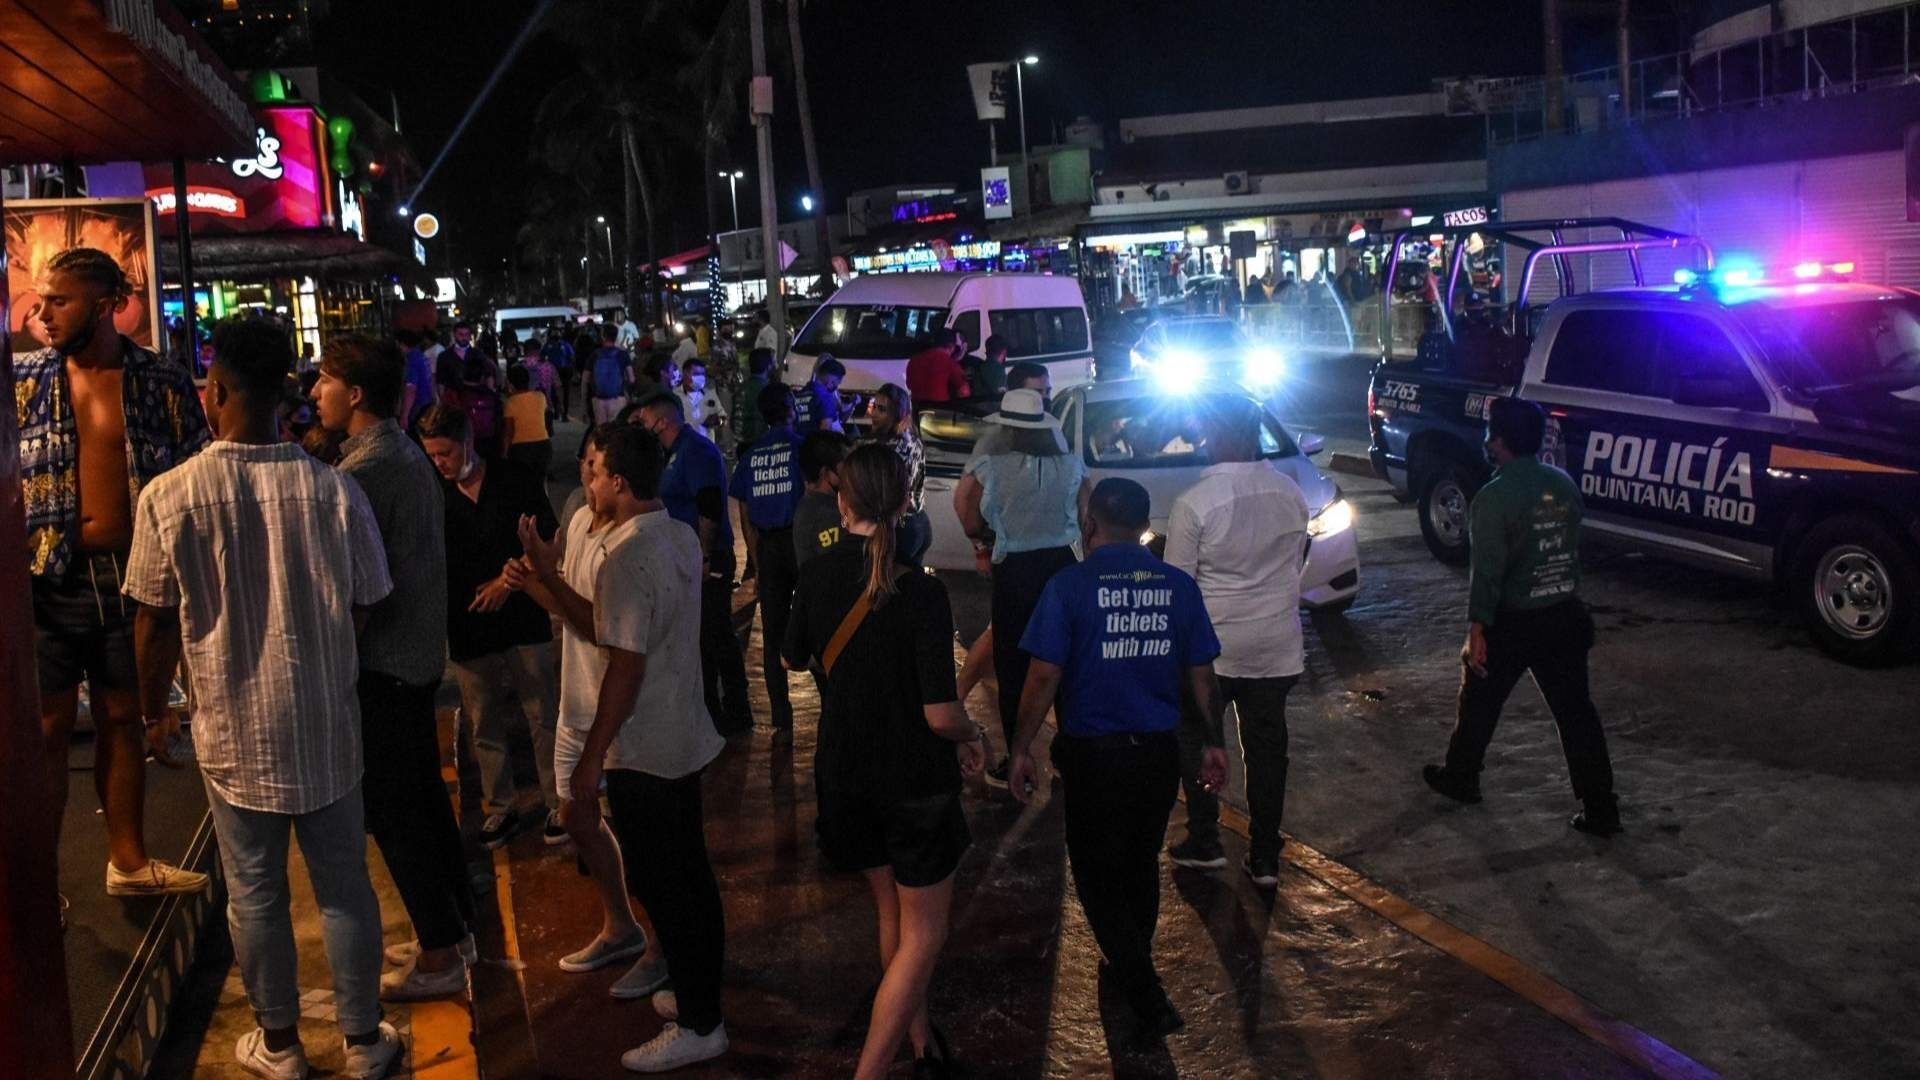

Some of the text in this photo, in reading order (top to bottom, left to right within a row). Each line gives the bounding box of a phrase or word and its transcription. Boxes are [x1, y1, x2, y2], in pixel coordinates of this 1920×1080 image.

[1444, 208, 1486, 227] TACOS
[1382, 380, 1420, 401] 5765
[750, 451, 792, 468] Get your
[1583, 430, 1753, 499] POLICÍA
[754, 466, 790, 482] tickets
[752, 481, 793, 497] with me
[1581, 472, 1757, 526] QUINTANA ROO
[818, 527, 839, 548] 97
[1097, 587, 1173, 609] Get your
[1106, 611, 1169, 634] tickets
[1101, 636, 1171, 660] with me
